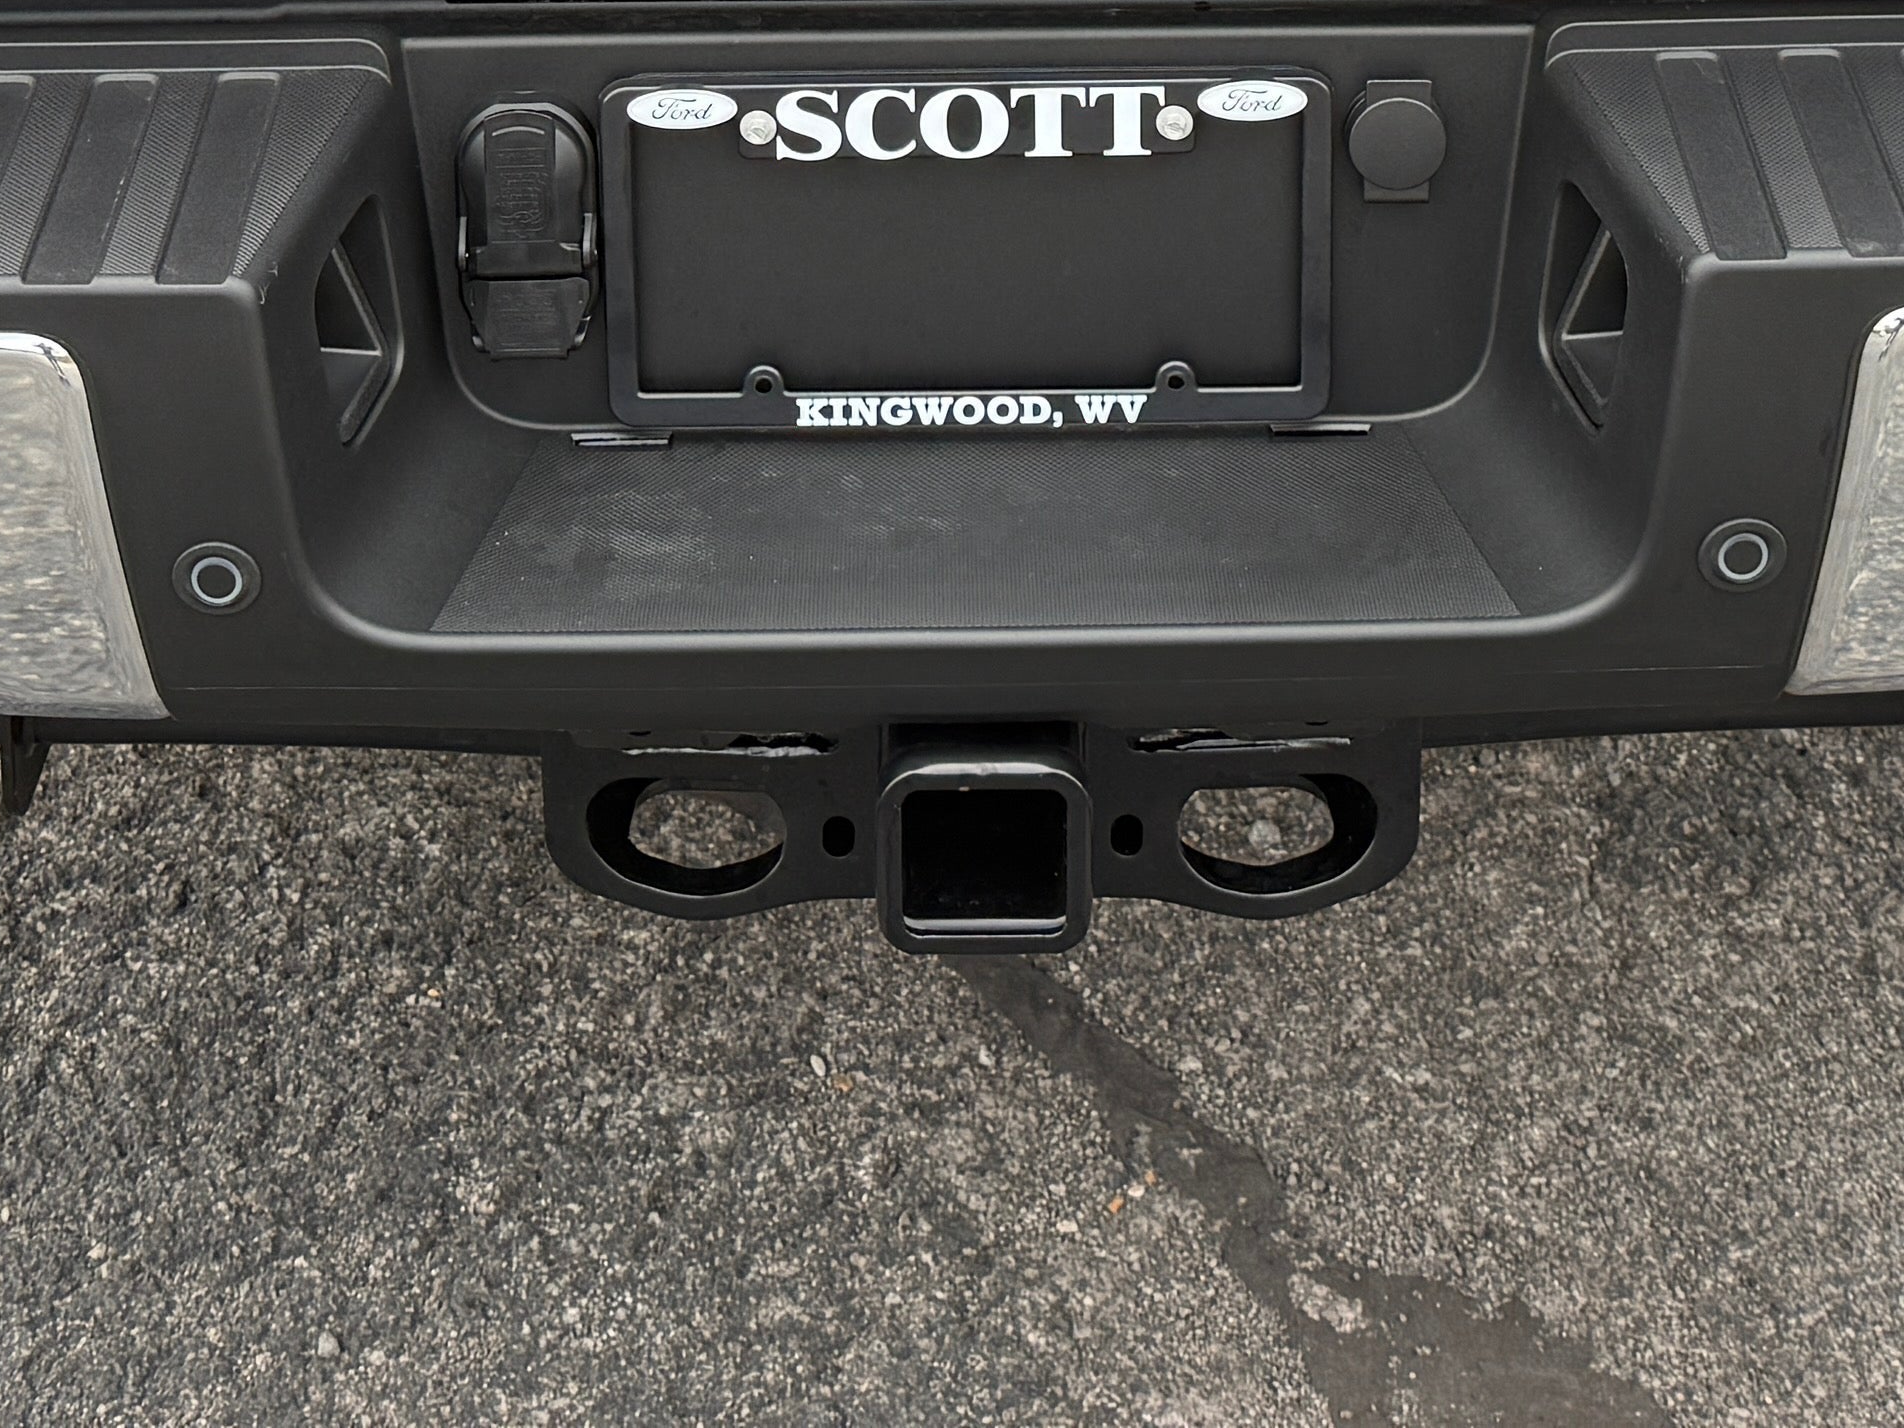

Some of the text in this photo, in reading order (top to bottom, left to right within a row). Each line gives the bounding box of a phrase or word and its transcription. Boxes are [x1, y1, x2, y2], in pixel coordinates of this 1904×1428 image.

[650, 97, 713, 121] Ford
[1221, 88, 1284, 113] Ford
[774, 85, 1166, 162] SCOTT
[796, 394, 1148, 428] KINGWOOD, WV
